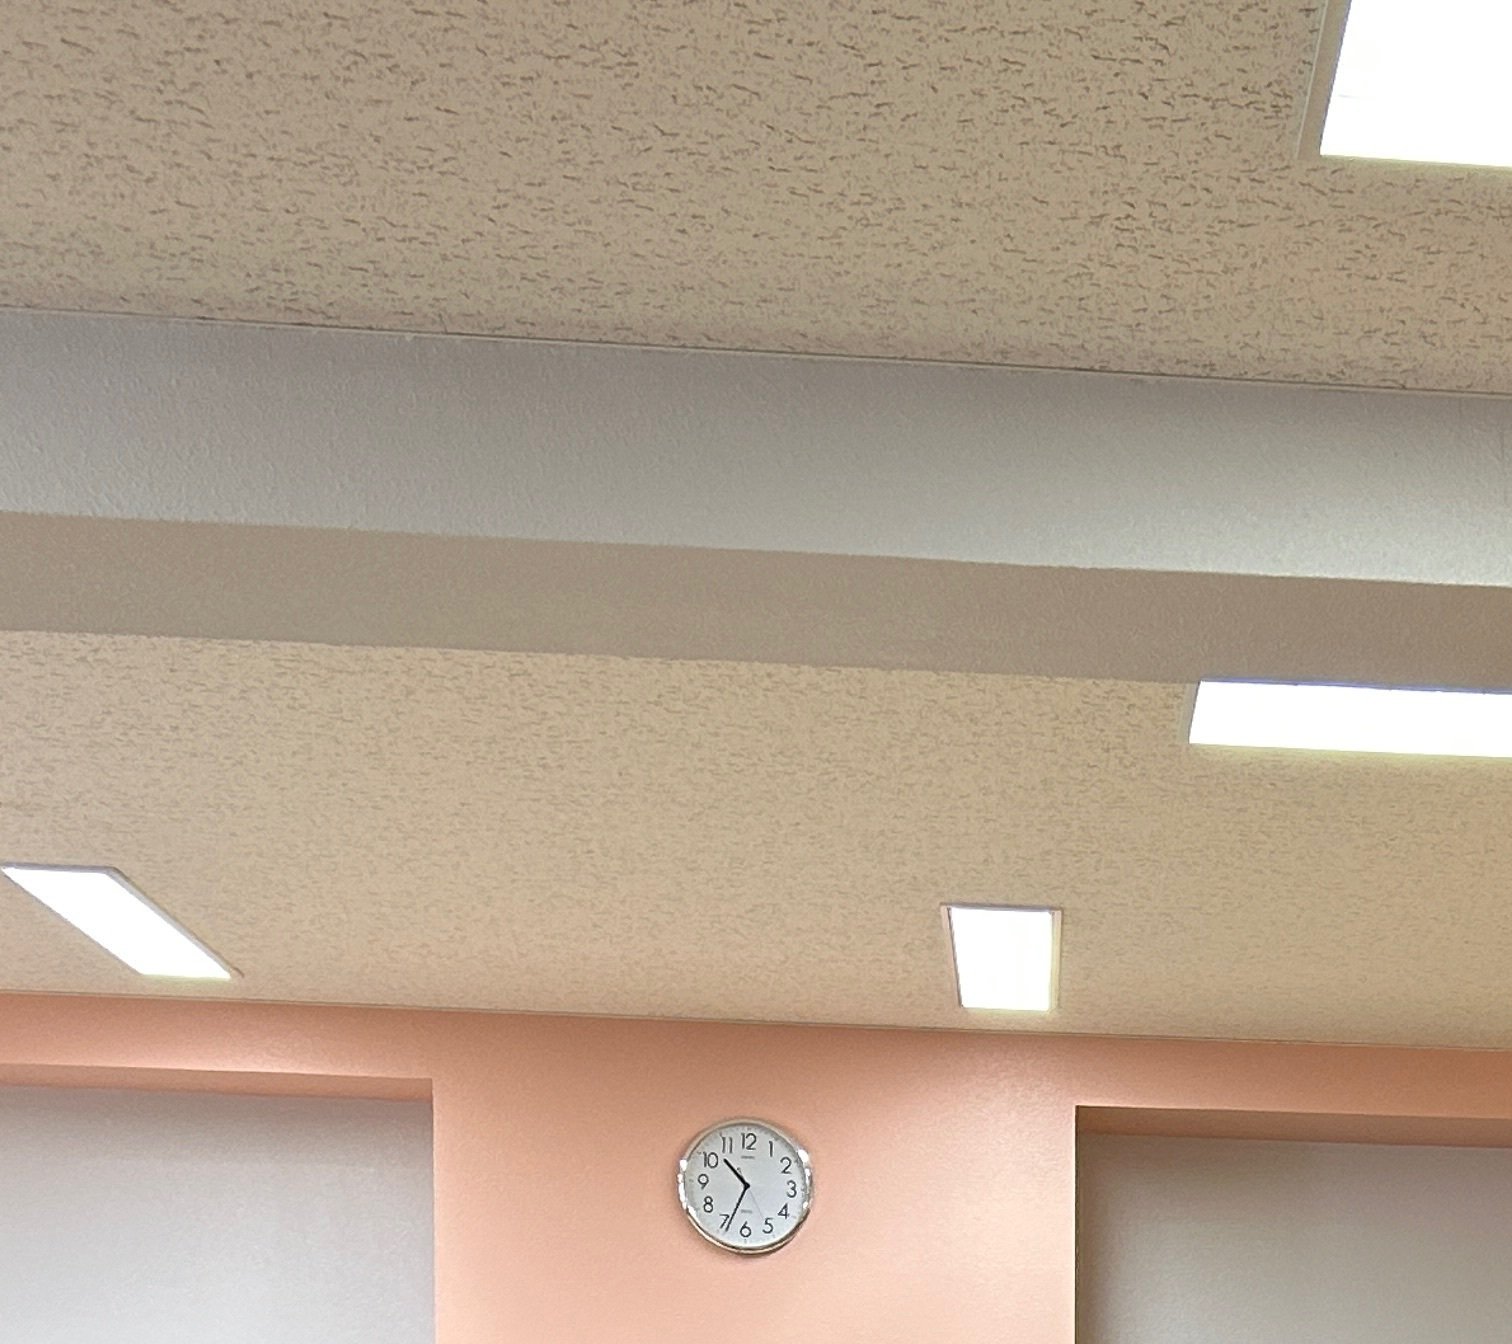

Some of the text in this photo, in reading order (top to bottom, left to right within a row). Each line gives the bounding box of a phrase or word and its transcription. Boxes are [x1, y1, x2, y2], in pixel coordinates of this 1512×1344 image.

[721, 1136, 733, 1154] 11
[741, 1132, 757, 1150] 12
[768, 1140, 774, 1157] 1
[702, 1151, 719, 1168] 10
[779, 1157, 792, 1174] 2
[697, 1173, 709, 1190] 9
[786, 1180, 797, 1198] 3
[703, 1196, 714, 1213] 8
[777, 1203, 790, 1219] 4
[719, 1214, 730, 1229] 7
[739, 1220, 752, 1238] 6
[762, 1217, 774, 1234] 5
